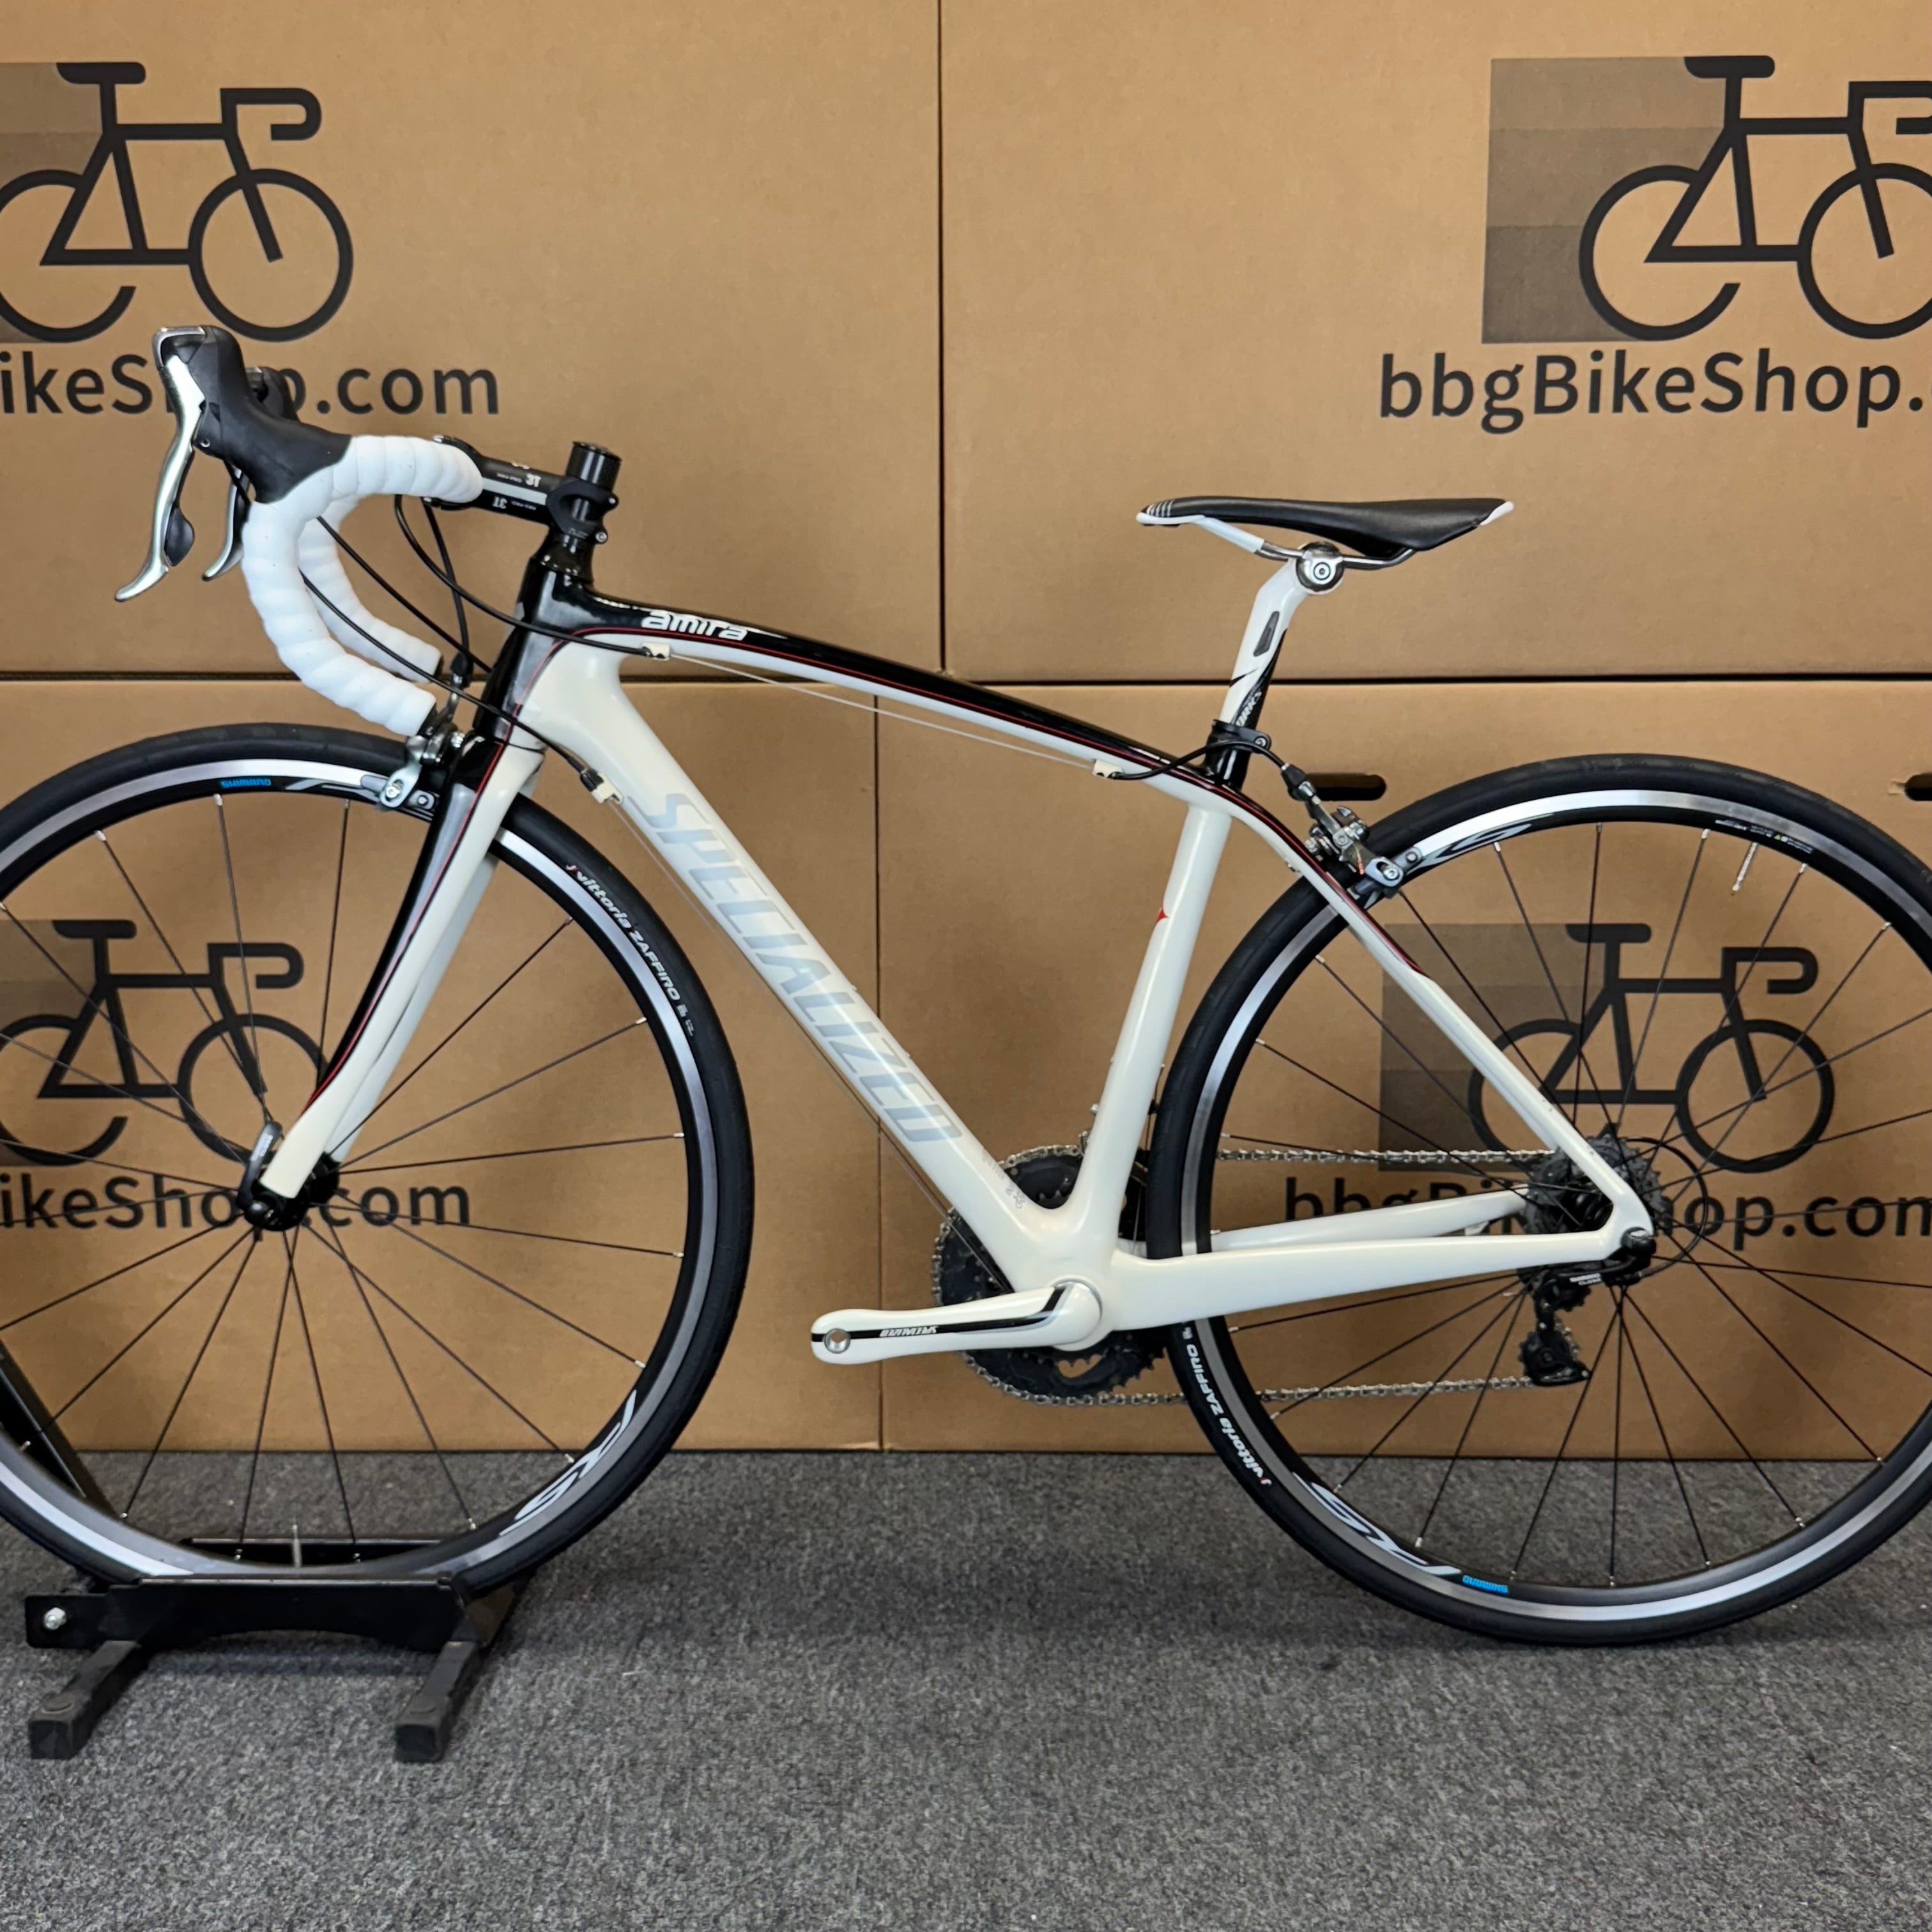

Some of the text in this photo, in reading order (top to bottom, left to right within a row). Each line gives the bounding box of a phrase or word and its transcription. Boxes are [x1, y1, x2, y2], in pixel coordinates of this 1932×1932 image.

[1380, 348, 1932, 435] bbgBikeShop.
[641, 610, 748, 641] amira
[576, 870, 681, 1001] vittoria ZAFFIRO
[625, 792, 963, 1143] SPECIALIZED
[0, 1172, 470, 1241] ikeSho.com
[1186, 1344, 1264, 1478] vittoria ZAFFIRO
